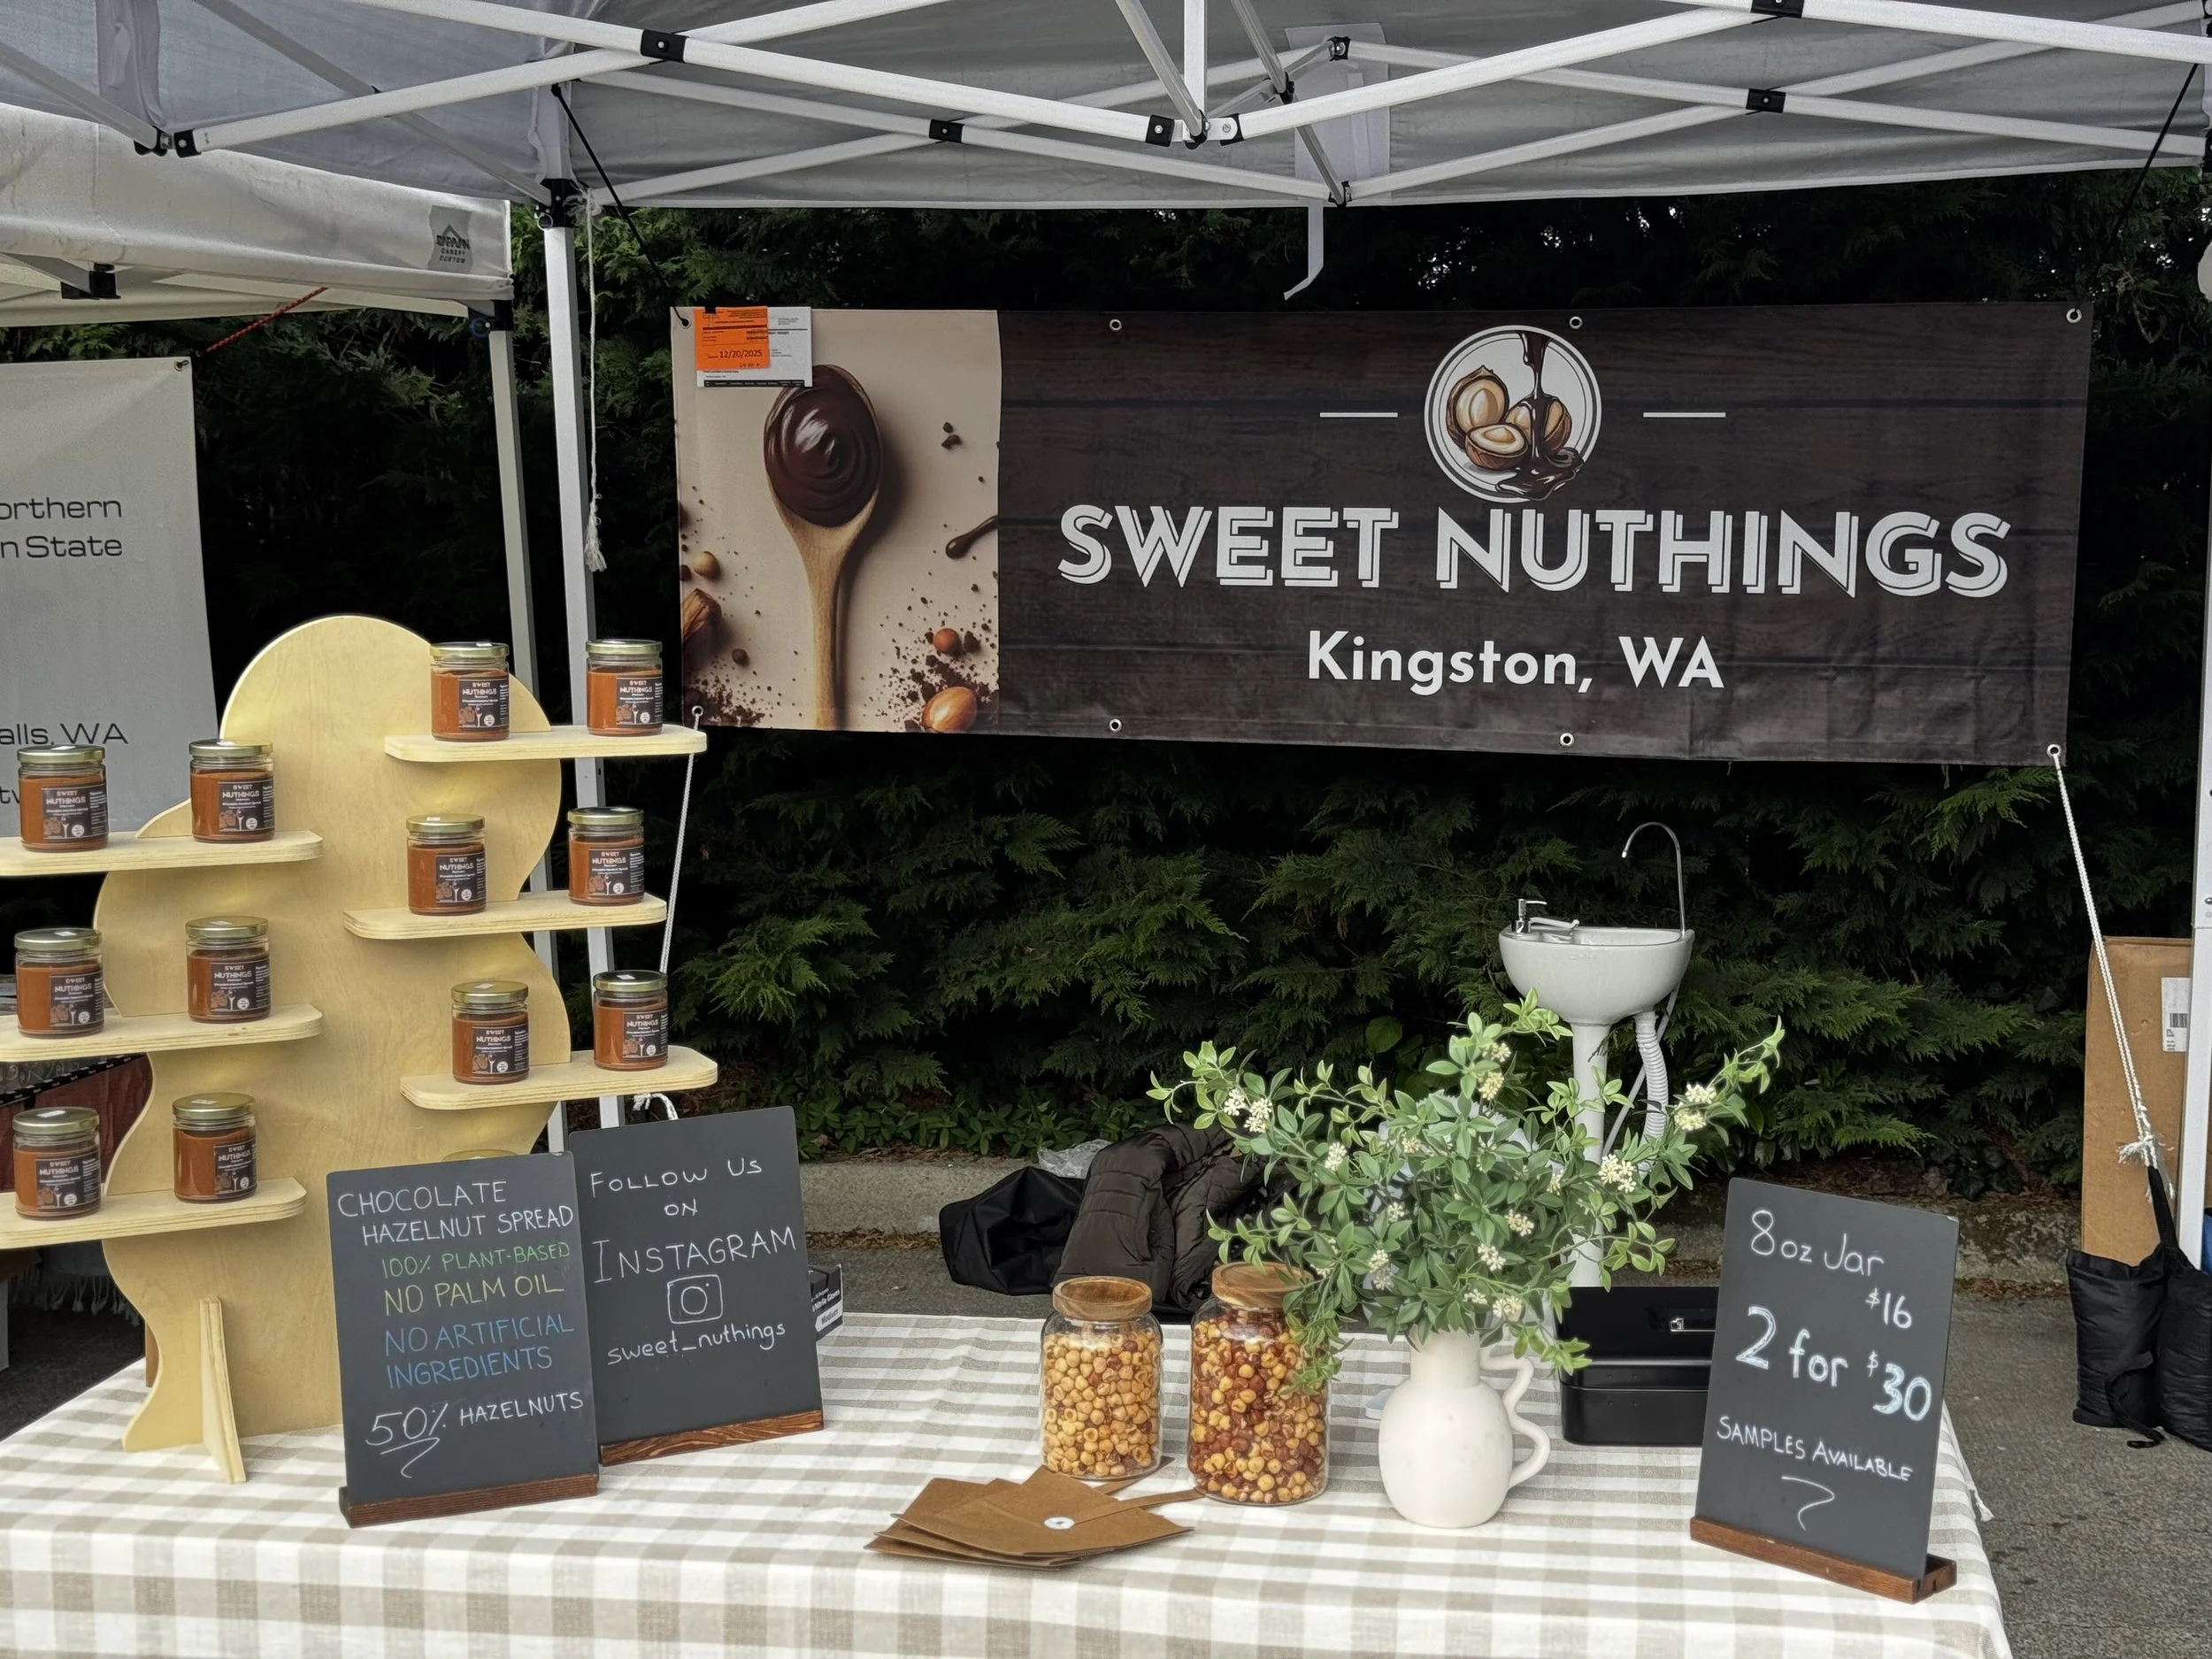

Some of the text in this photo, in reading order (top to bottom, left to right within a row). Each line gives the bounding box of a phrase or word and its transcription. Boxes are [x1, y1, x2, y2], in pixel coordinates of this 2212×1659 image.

[719, 349, 763, 358] 12/20/2025
[0, 496, 122, 520] orthern
[26, 535, 123, 558] State
[1058, 505, 2009, 597] SWEET NUTHINGS
[1310, 631, 1724, 695] Kingston, WA
[60, 723, 129, 744] WA
[337, 1181, 507, 1217] CHOCOLATE
[362, 1205, 573, 1246] HAZELNUT SPREAD
[382, 1241, 571, 1279] 100% PLANT-BASED
[593, 1226, 796, 1284] INSTAGRAM
[1824, 1233, 1885, 1277] Jar
[384, 1274, 565, 1316] NO PALM OIL
[1865, 1287, 1912, 1329] $16
[385, 1314, 574, 1357] NO ARTIFICIAL
[608, 1323, 786, 1366] sweet_nuthings
[387, 1346, 553, 1389] INGREDIENTS
[1736, 1306, 1932, 1422] 2 for $30
[365, 1392, 584, 1447] 50% HAZELNUTS
[1717, 1416, 1913, 1482] SAMPLES AVAILABLE
